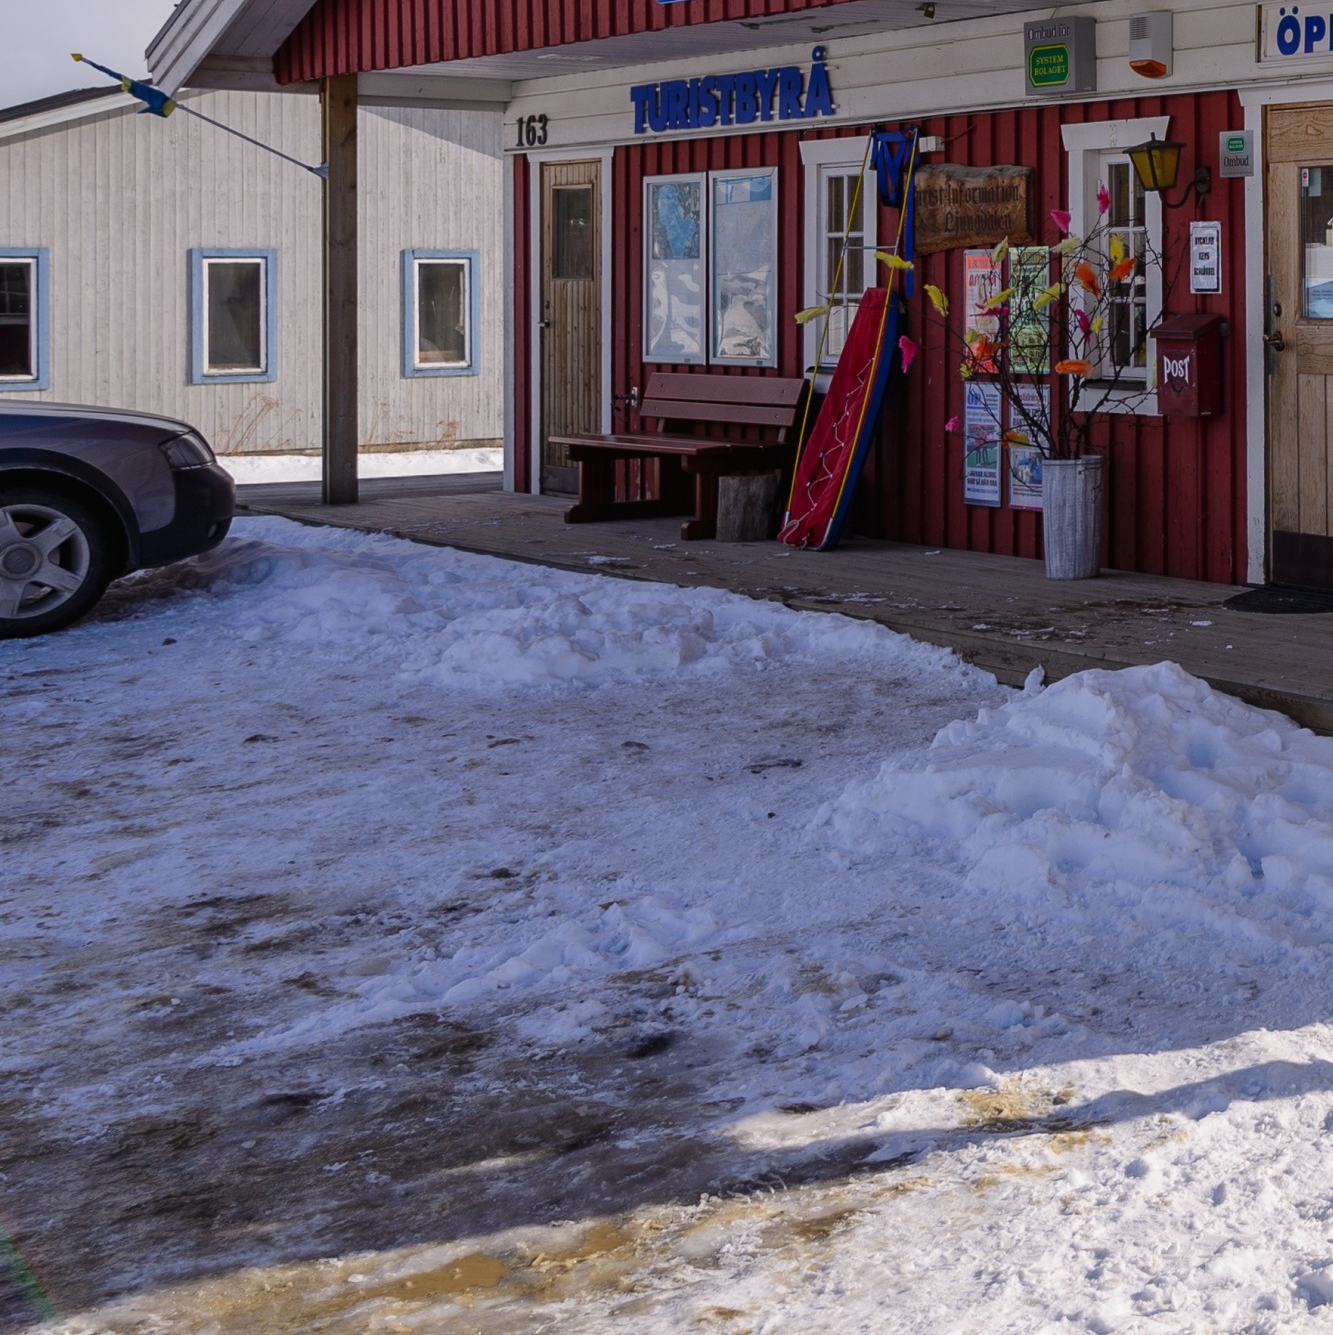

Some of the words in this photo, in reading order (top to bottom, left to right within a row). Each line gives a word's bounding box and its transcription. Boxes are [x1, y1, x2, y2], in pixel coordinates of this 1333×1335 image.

[1027, 24, 1057, 41] Ombud
[1034, 65, 1067, 76] BOLAGET
[1035, 54, 1064, 66] SYSTEM
[630, 45, 837, 134] TURISTBYRÅ
[515, 113, 550, 147] 163
[1163, 354, 1190, 385] POST
